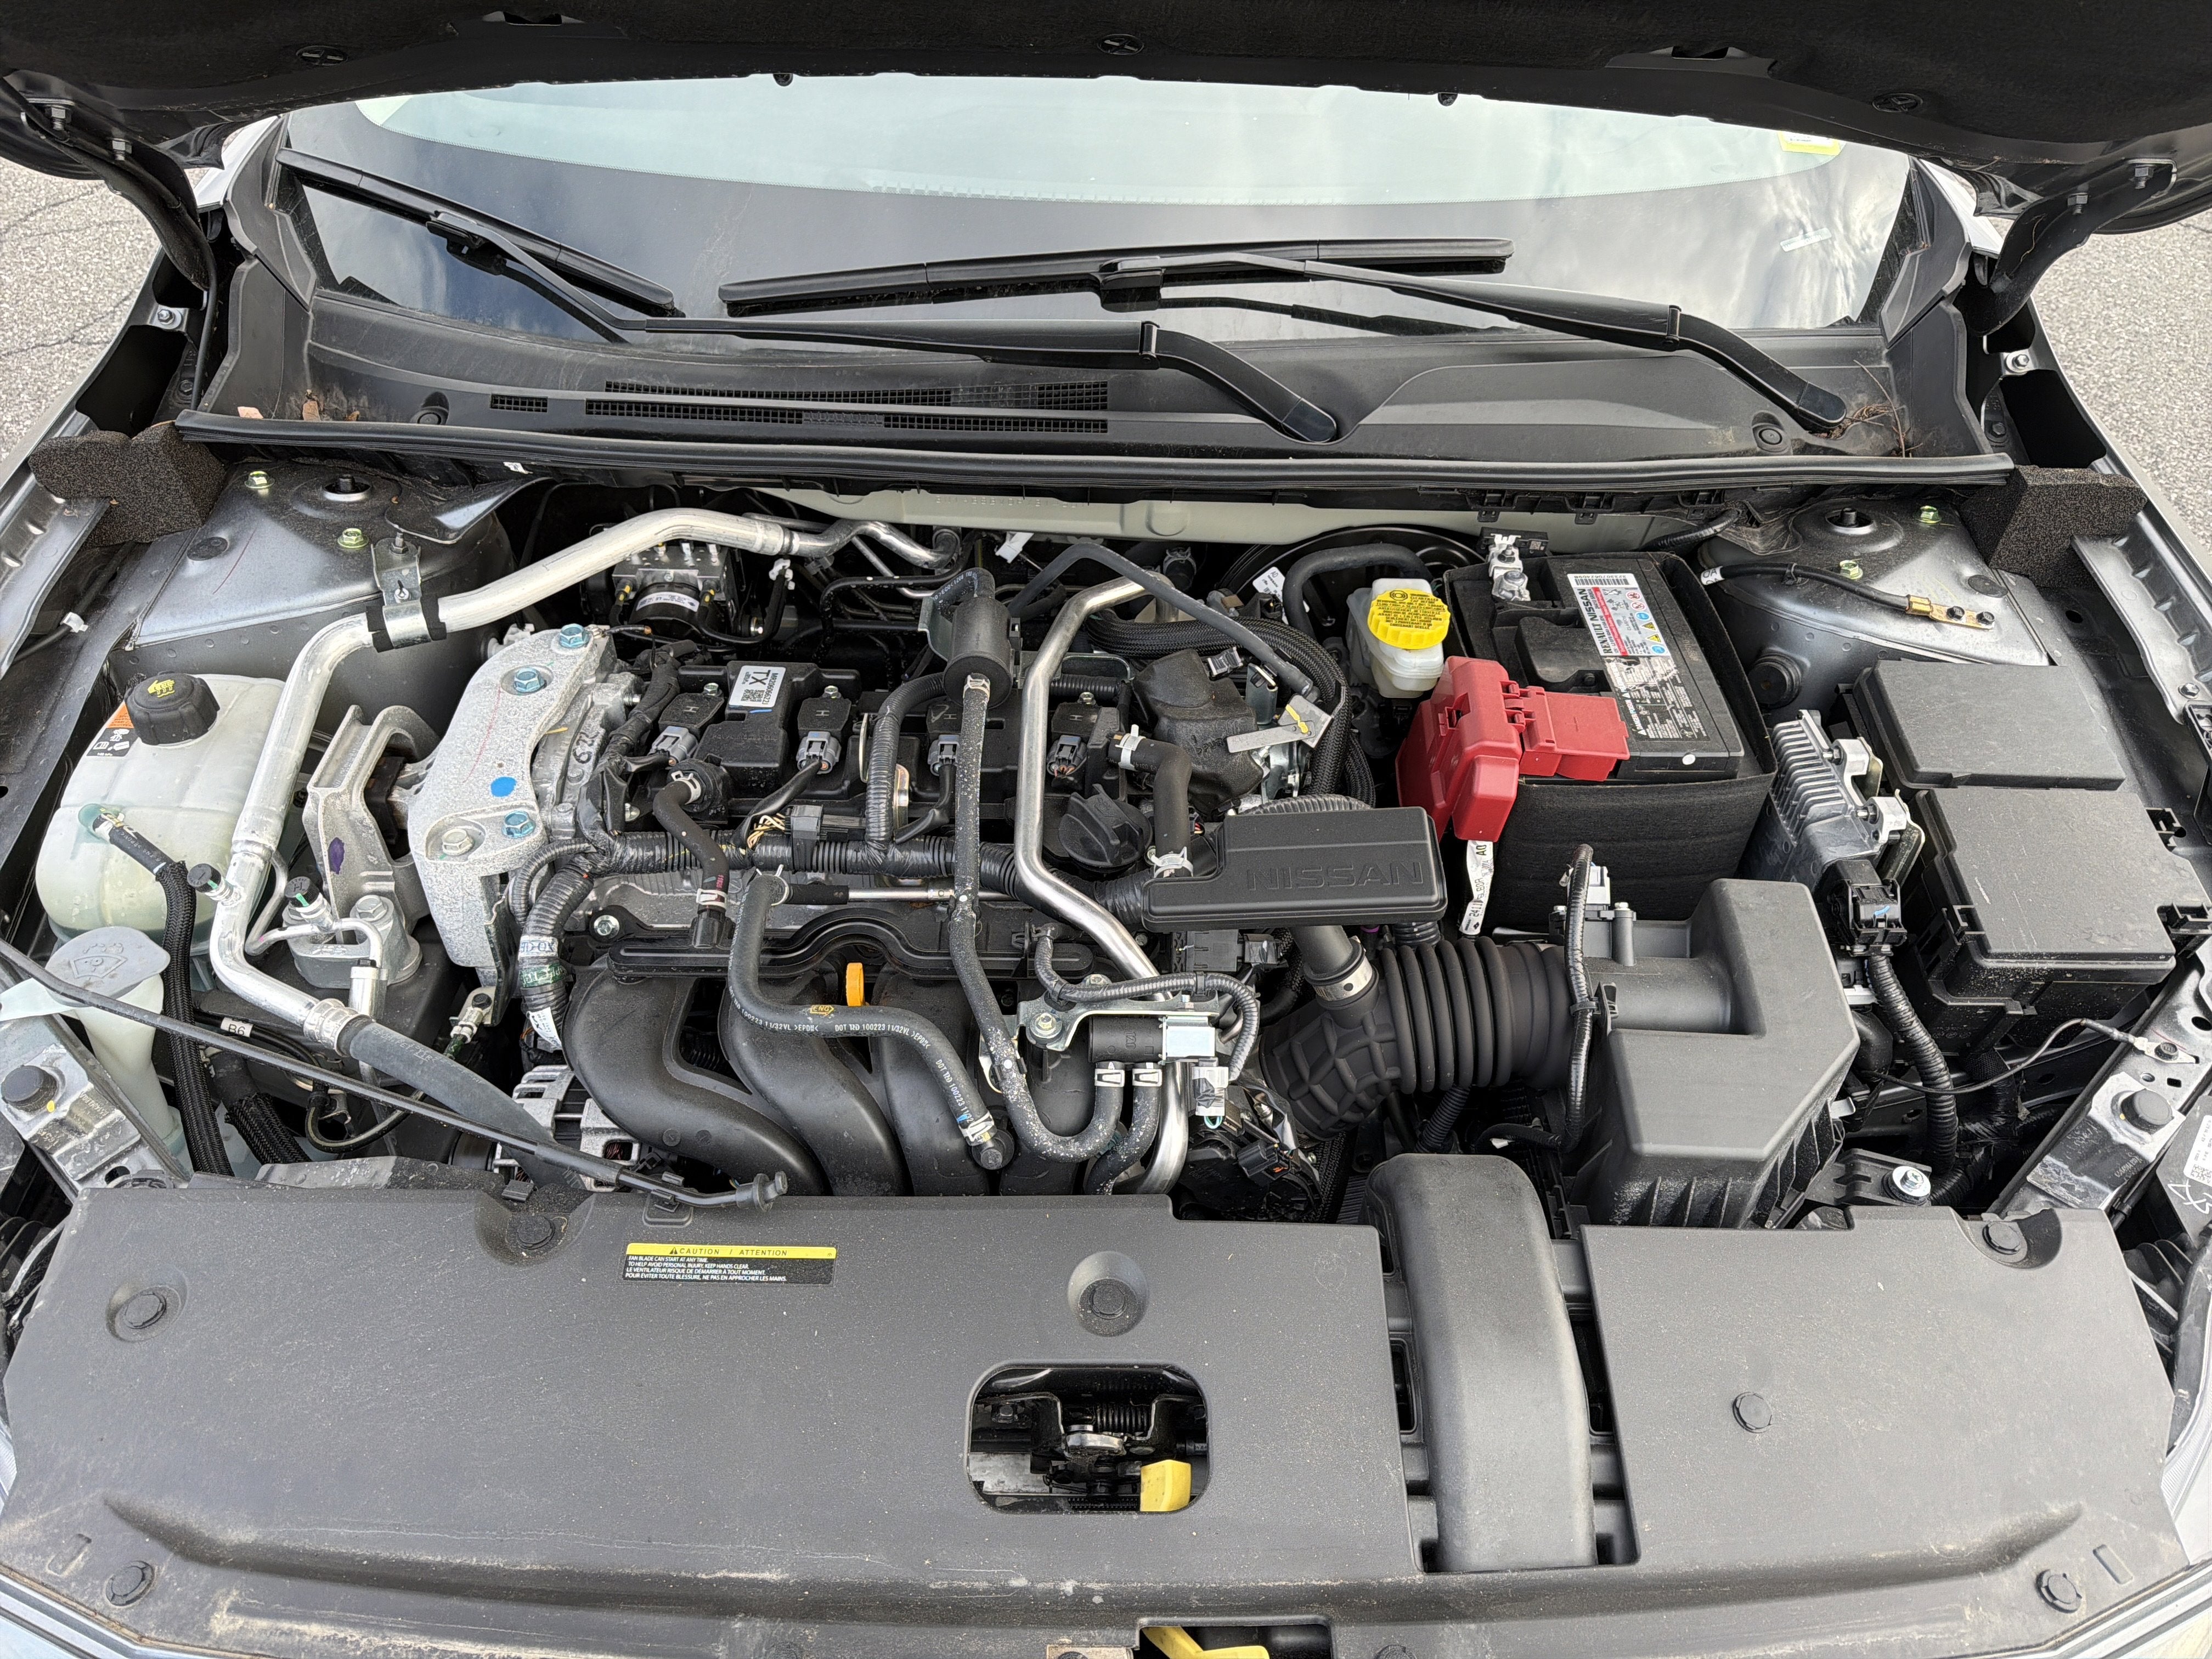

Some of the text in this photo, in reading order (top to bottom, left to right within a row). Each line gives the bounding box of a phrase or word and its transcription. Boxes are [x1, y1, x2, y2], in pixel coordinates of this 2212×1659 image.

[1577, 589, 1598, 621] NISSAN
[1592, 623, 1613, 654] RENAULT
[749, 669, 771, 686] TX
[1246, 861, 1424, 891] NISSAN
[228, 1023, 246, 1036] B6
[741, 1008, 763, 1026] 100223
[765, 1021, 792, 1031] 11/32VL
[834, 1024, 847, 1032] DOT
[862, 1023, 886, 1031] 100223
[887, 1024, 910, 1036] 11/32VL
[935, 1059, 946, 1072] DOT
[949, 1082, 964, 1107] 100223
